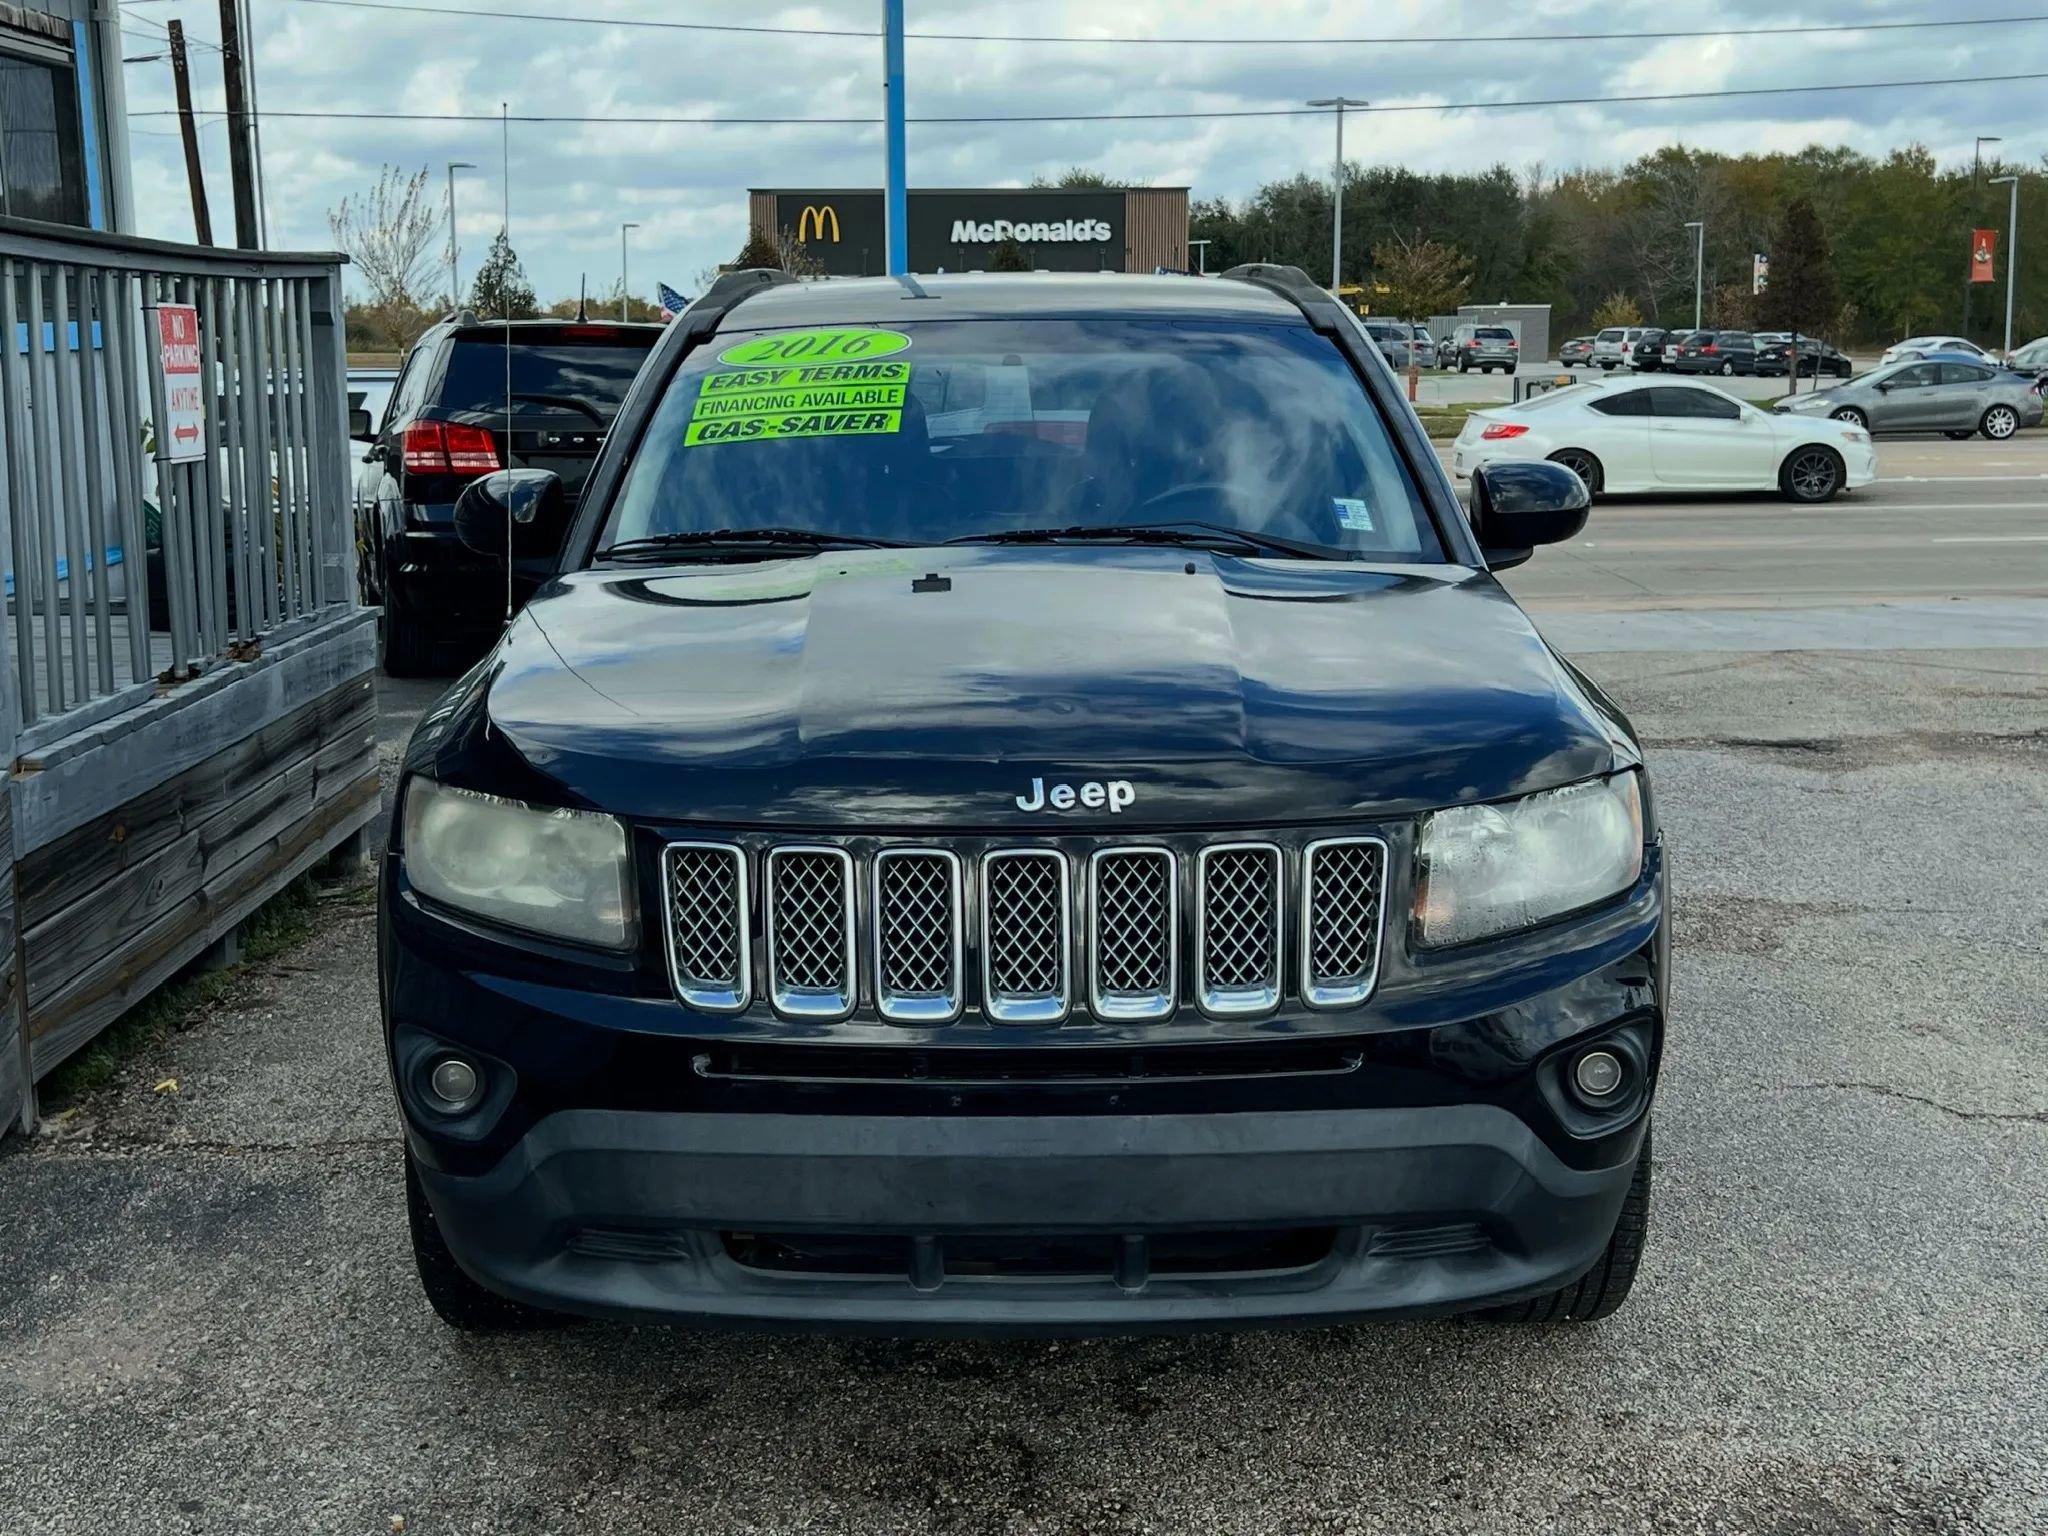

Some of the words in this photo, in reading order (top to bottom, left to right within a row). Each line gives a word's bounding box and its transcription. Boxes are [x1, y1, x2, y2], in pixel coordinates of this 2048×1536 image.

[950, 218, 1112, 243] McDonald's
[172, 315, 185, 339] NO
[165, 343, 198, 368] PARKING
[747, 332, 879, 362] 2016
[707, 369, 790, 391] EASY
[798, 364, 906, 384] TERMS
[699, 394, 795, 417] FINANCING
[800, 389, 898, 407] AVAILABLE
[697, 413, 893, 441] GAS-SAVER
[1015, 777, 1136, 813] Jeep
